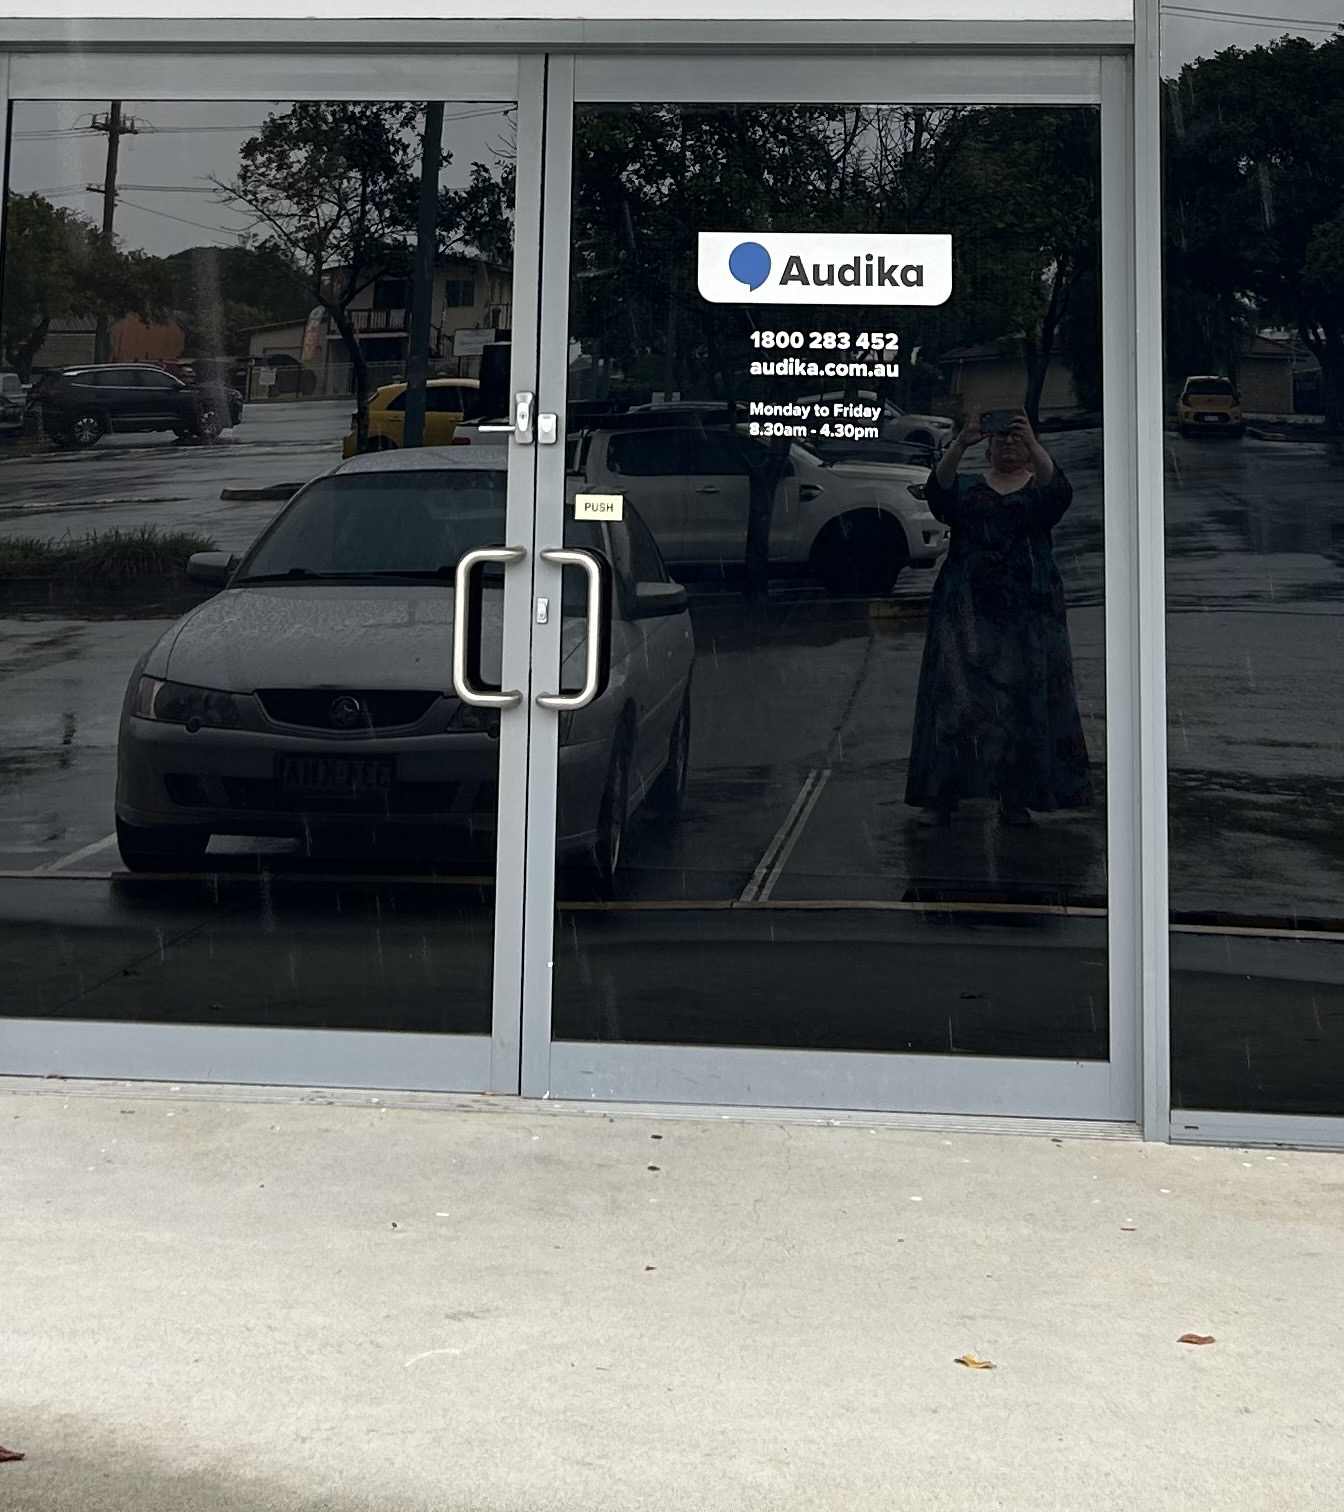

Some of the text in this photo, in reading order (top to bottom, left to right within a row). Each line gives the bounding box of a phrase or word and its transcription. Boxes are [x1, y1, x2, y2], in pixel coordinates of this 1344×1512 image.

[779, 253, 924, 287] Audika
[750, 331, 899, 350] 1800 283 452
[749, 357, 899, 378] audika.com.au
[749, 402, 882, 421] Monday to Friday
[749, 422, 807, 437] 8.30am
[819, 423, 879, 441] 4.30pm
[584, 502, 614, 512] PUSH
